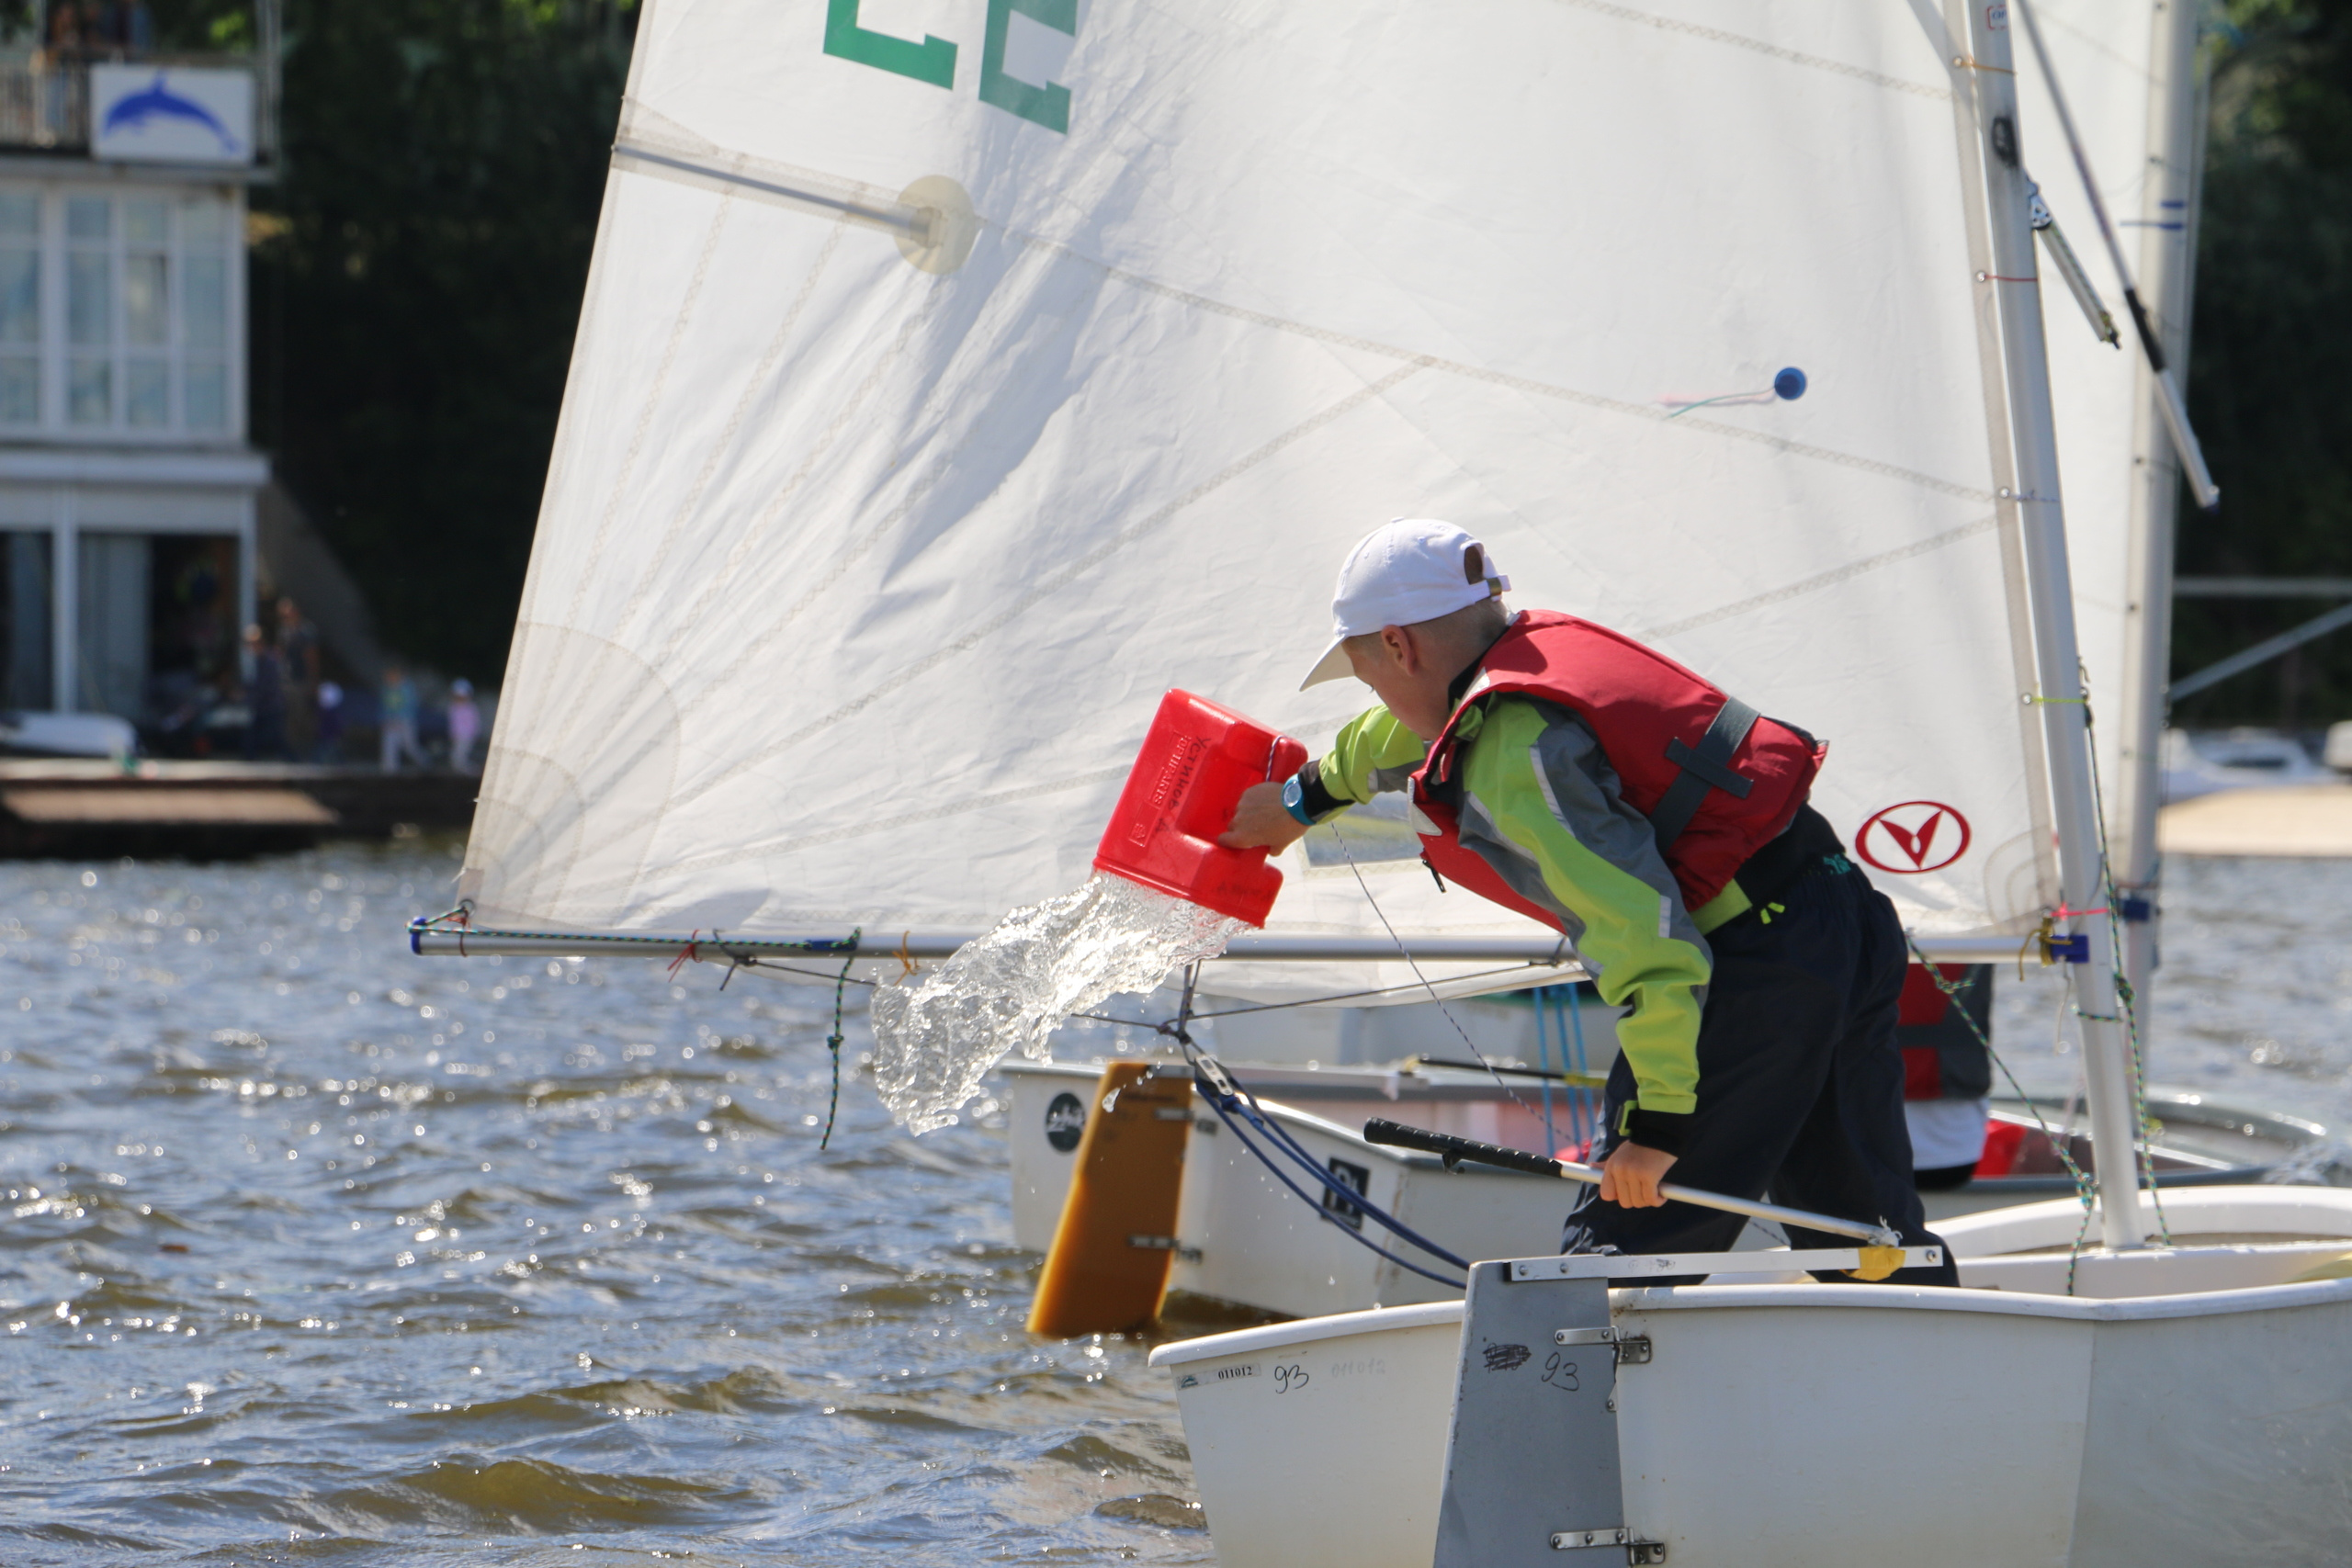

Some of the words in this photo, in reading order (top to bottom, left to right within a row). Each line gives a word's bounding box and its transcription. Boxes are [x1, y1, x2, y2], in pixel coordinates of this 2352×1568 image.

[1218, 1366, 1253, 1381] 011012
[1273, 1363, 1310, 1394] 93
[1541, 1351, 1579, 1392] 93
